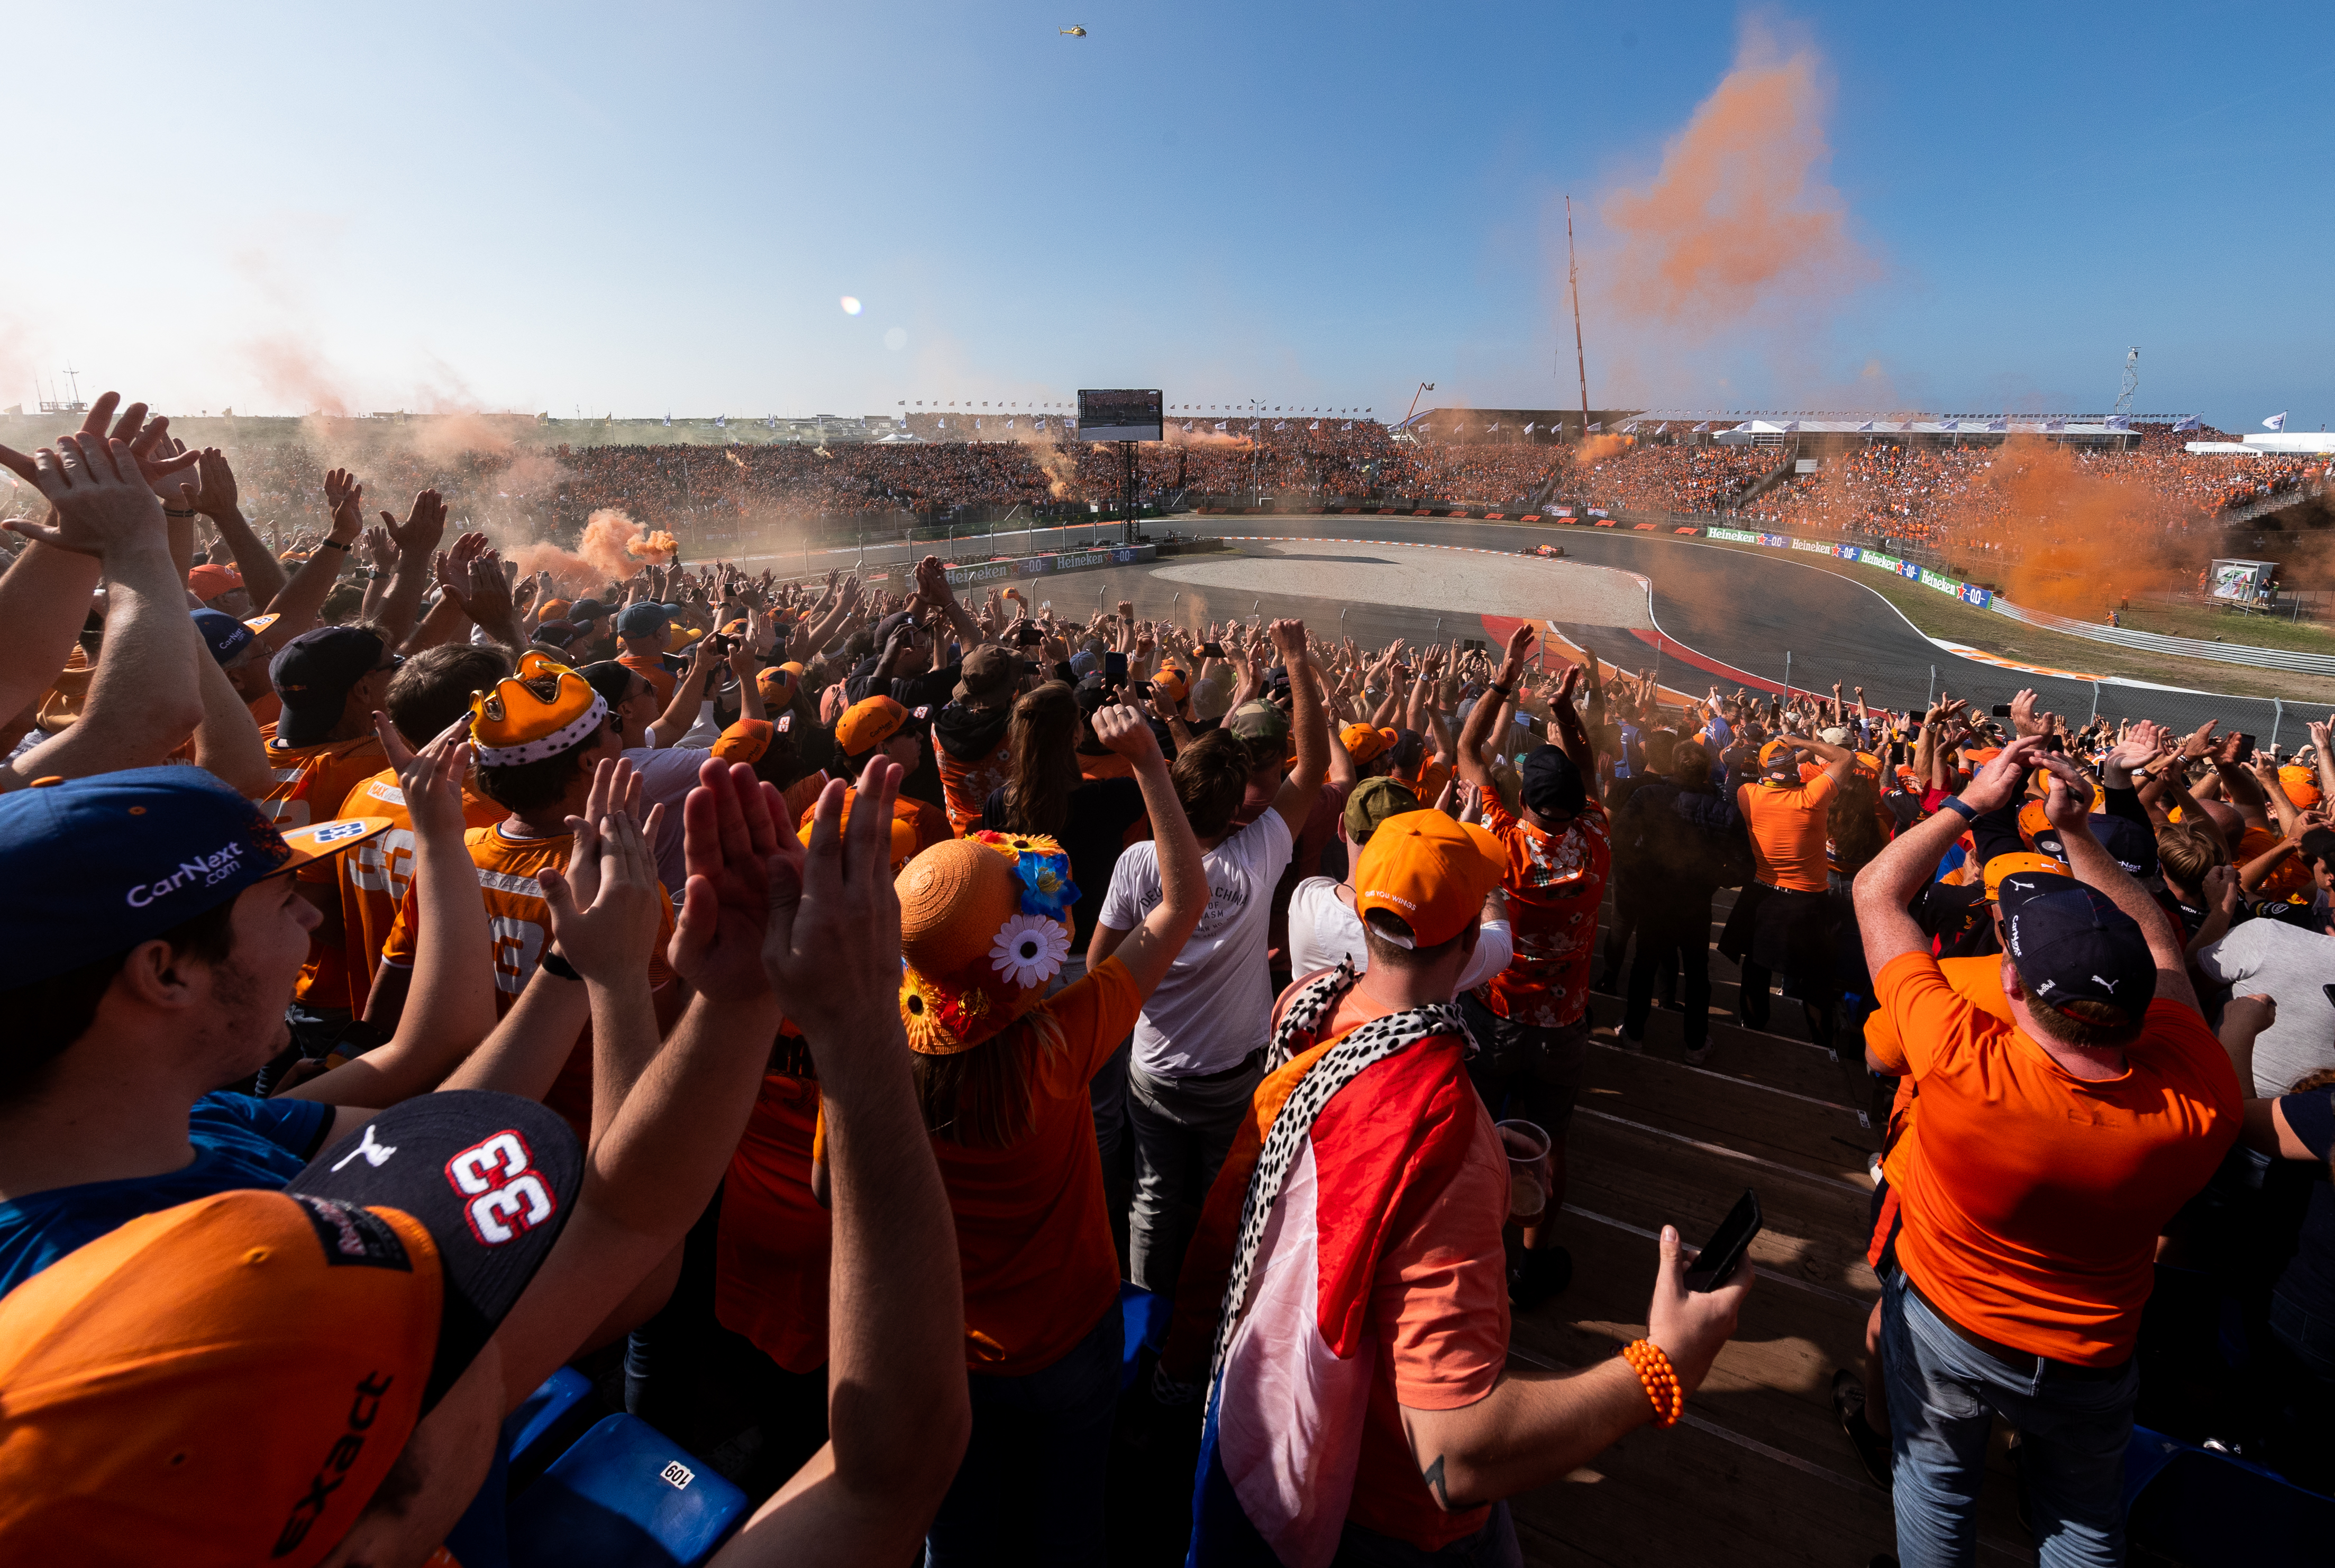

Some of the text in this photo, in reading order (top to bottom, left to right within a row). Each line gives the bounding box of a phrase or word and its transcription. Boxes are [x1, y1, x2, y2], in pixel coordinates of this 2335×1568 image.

[1708, 528, 1755, 543] Heineken
[1792, 538, 1830, 554] Heineken
[1057, 554, 1103, 569] Heineken
[1861, 551, 1895, 571] Heineken
[946, 565, 1006, 585] Heineken
[1921, 570, 1956, 595] Heineken
[219, 628, 243, 649] CarNext
[870, 720, 895, 738] CarNext
[126, 841, 243, 907] CarNext
[204, 860, 241, 887] .com
[1139, 886, 1163, 908] DEU
[1376, 890, 1390, 899] YOU
[1392, 895, 1417, 911] WINGS
[448, 1131, 554, 1245] 33
